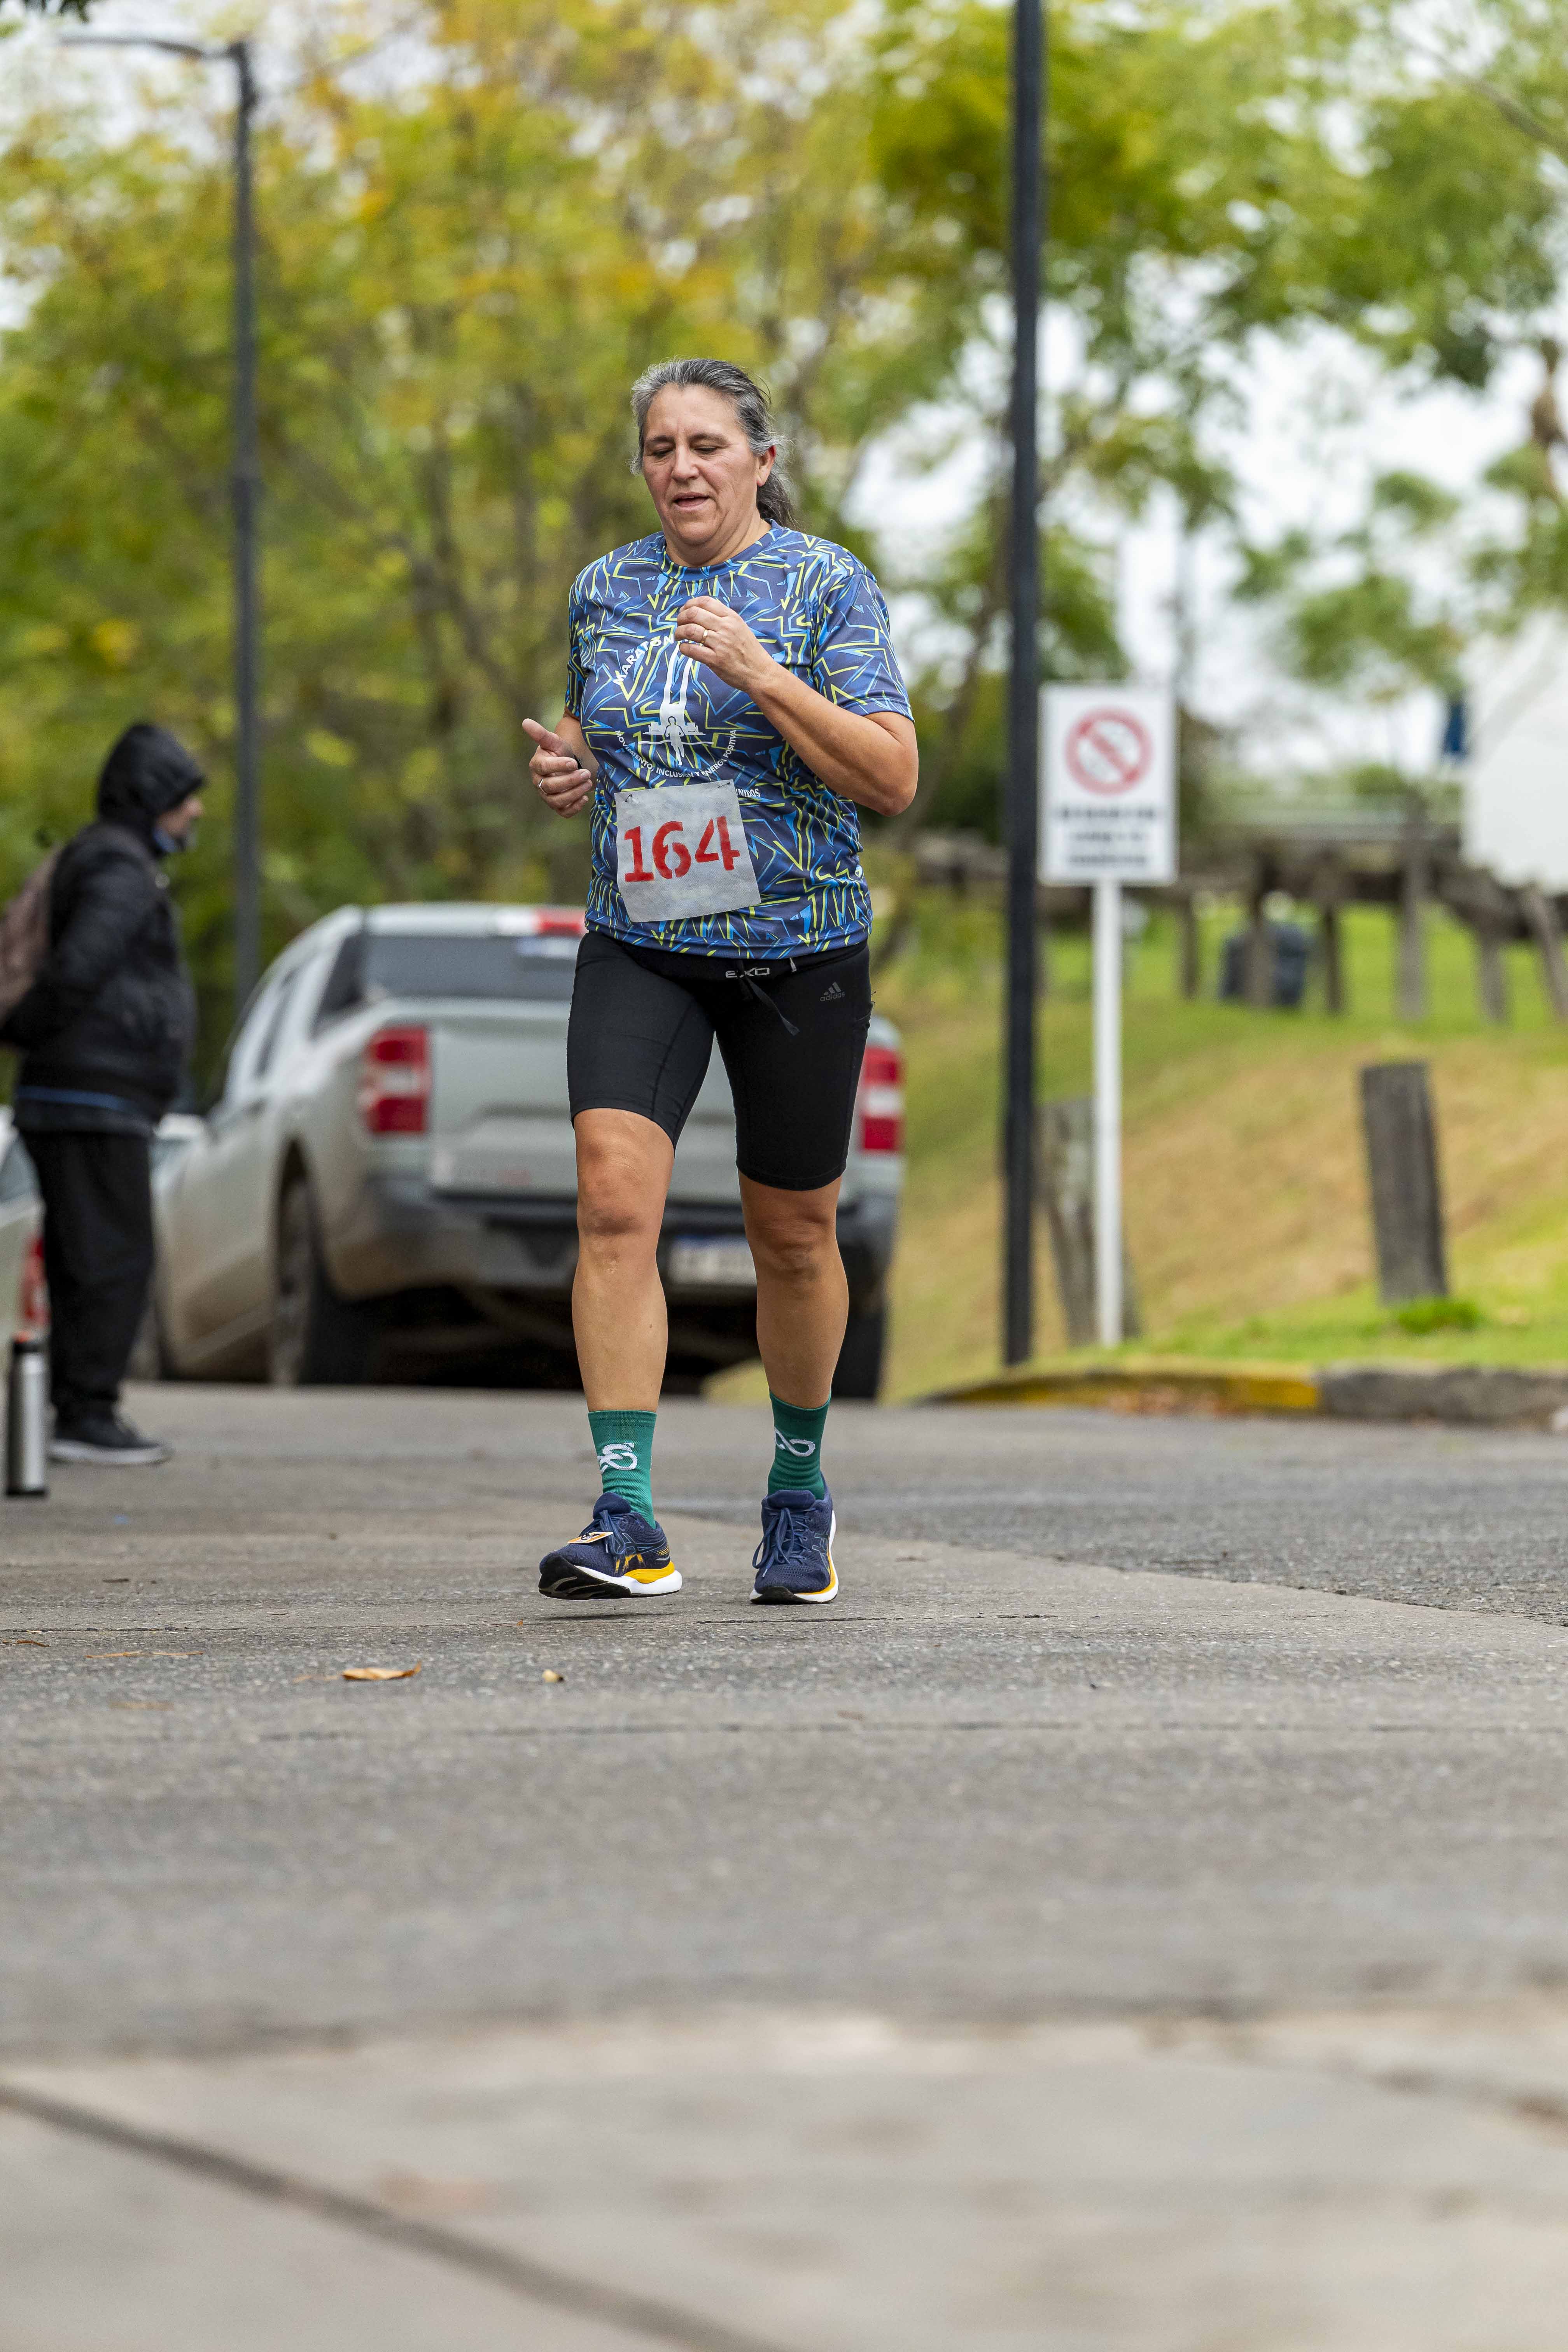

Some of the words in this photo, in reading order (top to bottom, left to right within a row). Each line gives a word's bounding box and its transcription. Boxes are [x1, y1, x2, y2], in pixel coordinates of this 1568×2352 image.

[615, 730, 654, 772] MOVIMIENTO,
[723, 730, 737, 758] POSITIVA
[624, 816, 741, 882] 164
[820, 992, 845, 1002] adidas
